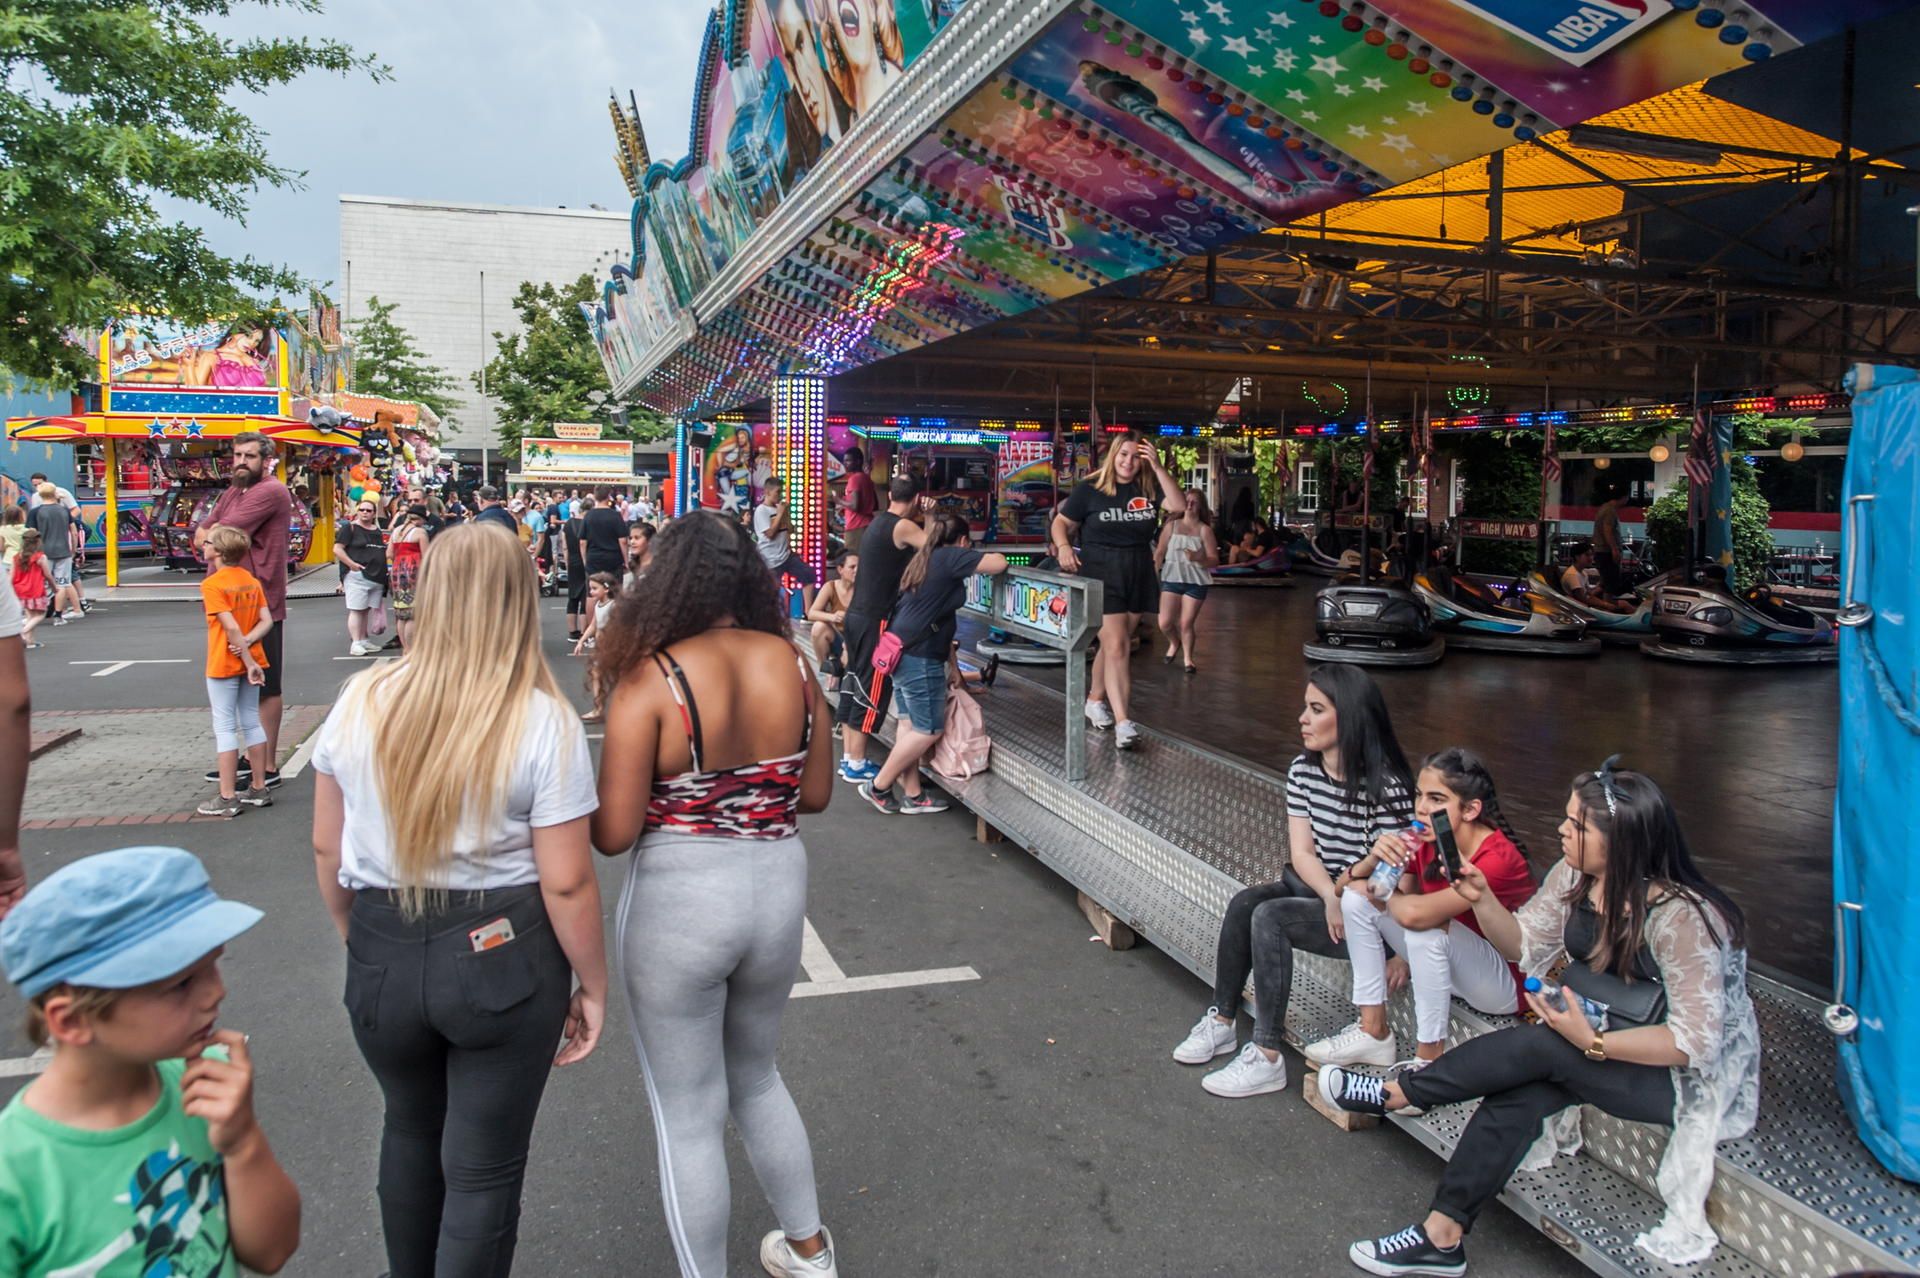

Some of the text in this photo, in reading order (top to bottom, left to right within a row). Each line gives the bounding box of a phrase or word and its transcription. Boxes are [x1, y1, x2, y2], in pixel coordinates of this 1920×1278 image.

[1546, 6, 1618, 48] NBA
[901, 431, 980, 445] AMERICAN DREAM
[1480, 522, 1501, 536] HIGH
[1504, 523, 1526, 537] WAY
